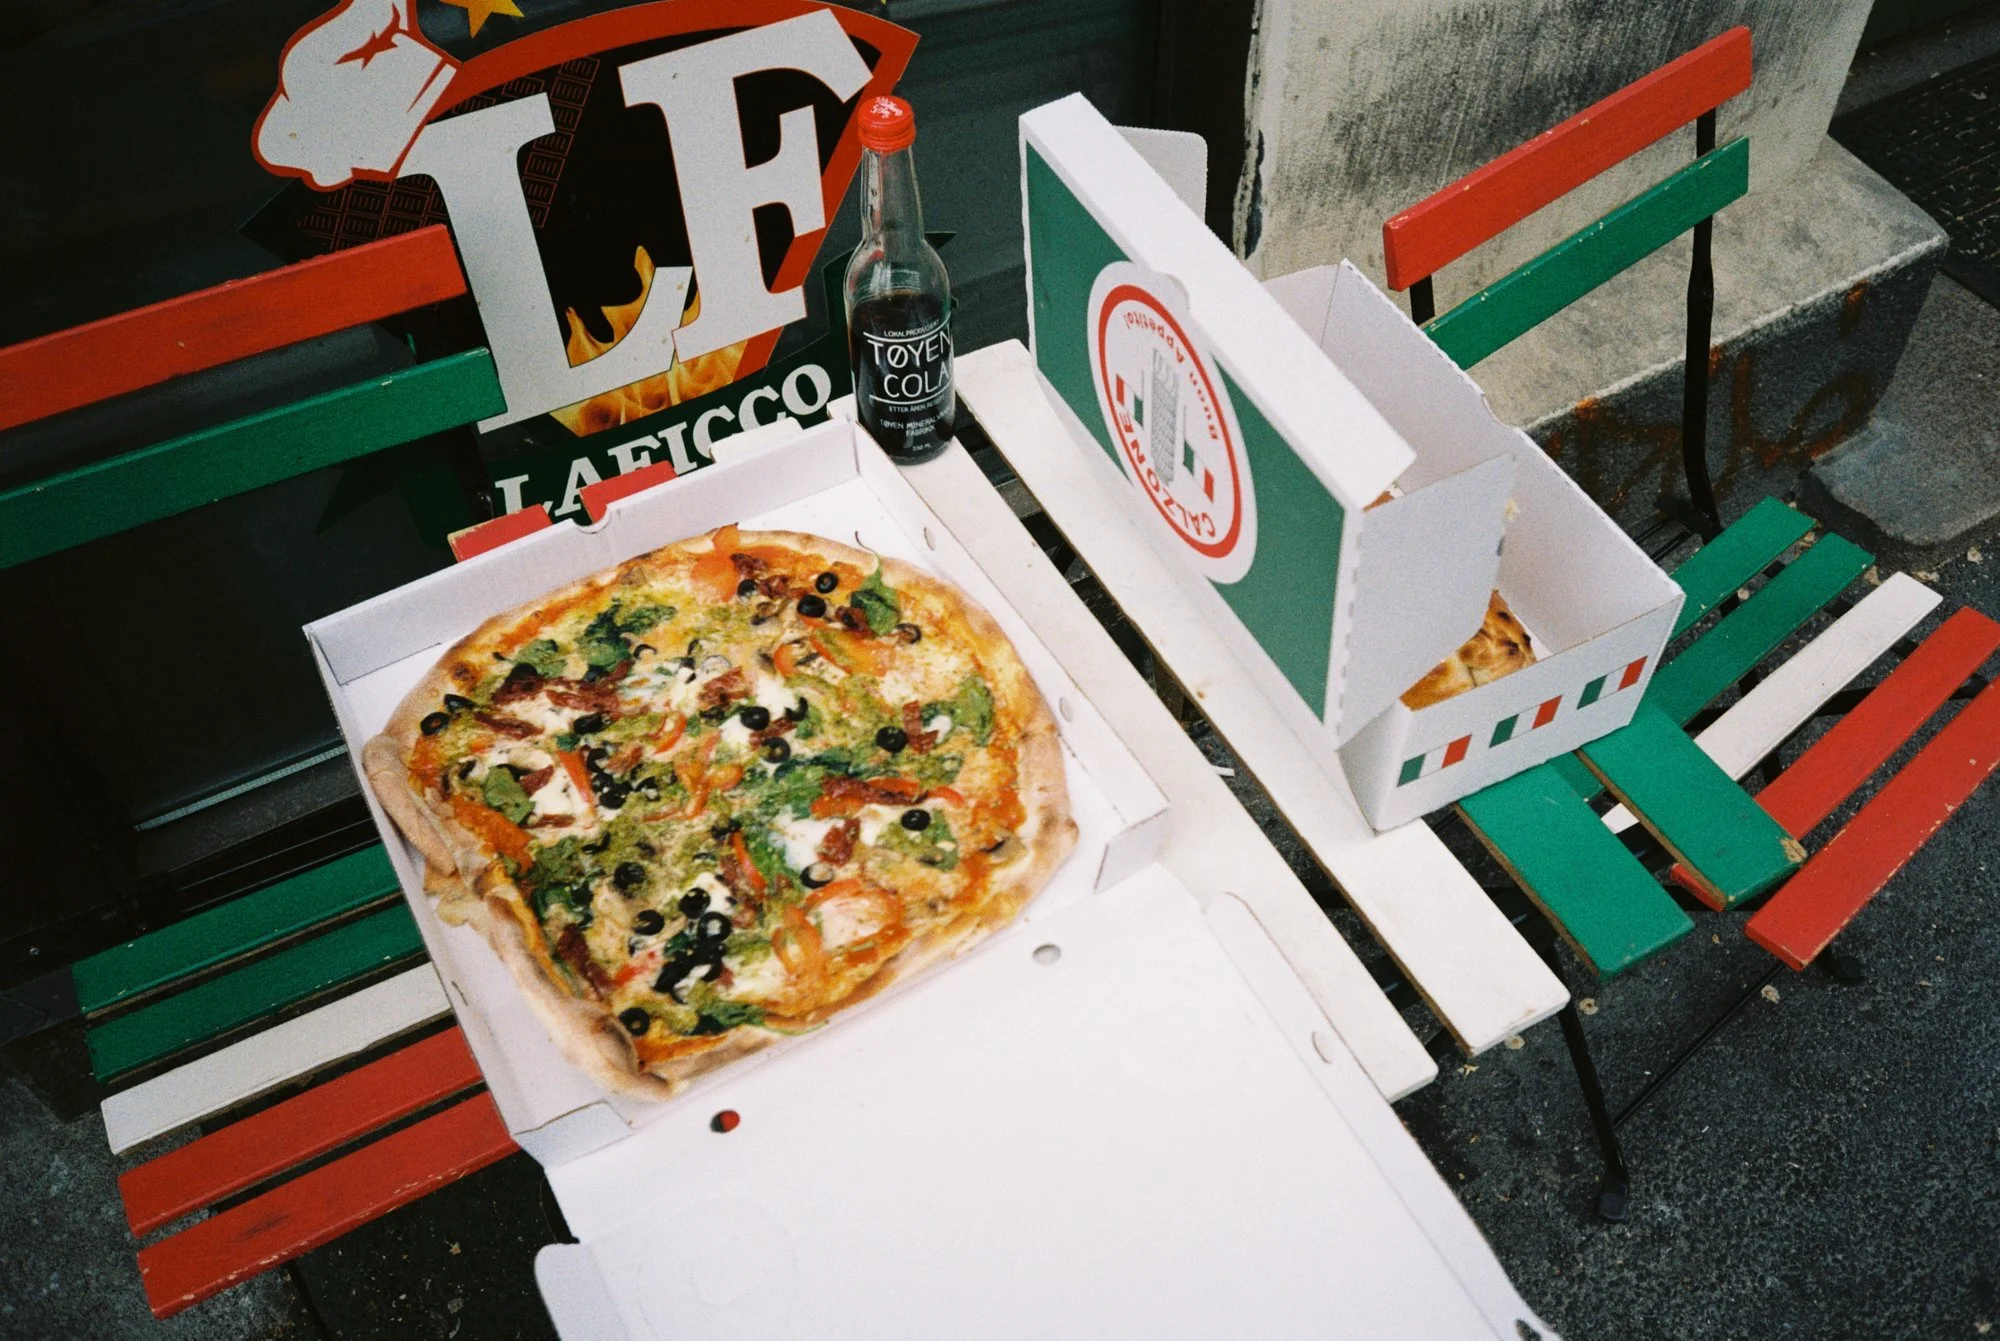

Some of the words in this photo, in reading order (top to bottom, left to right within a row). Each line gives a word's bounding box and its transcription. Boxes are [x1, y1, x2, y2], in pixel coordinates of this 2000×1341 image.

[397, 8, 874, 434] LF
[867, 323, 952, 368] TØYEN
[883, 361, 950, 398] COLA
[879, 418, 904, 429] TØYEN
[1119, 411, 1216, 539] CALZONE
